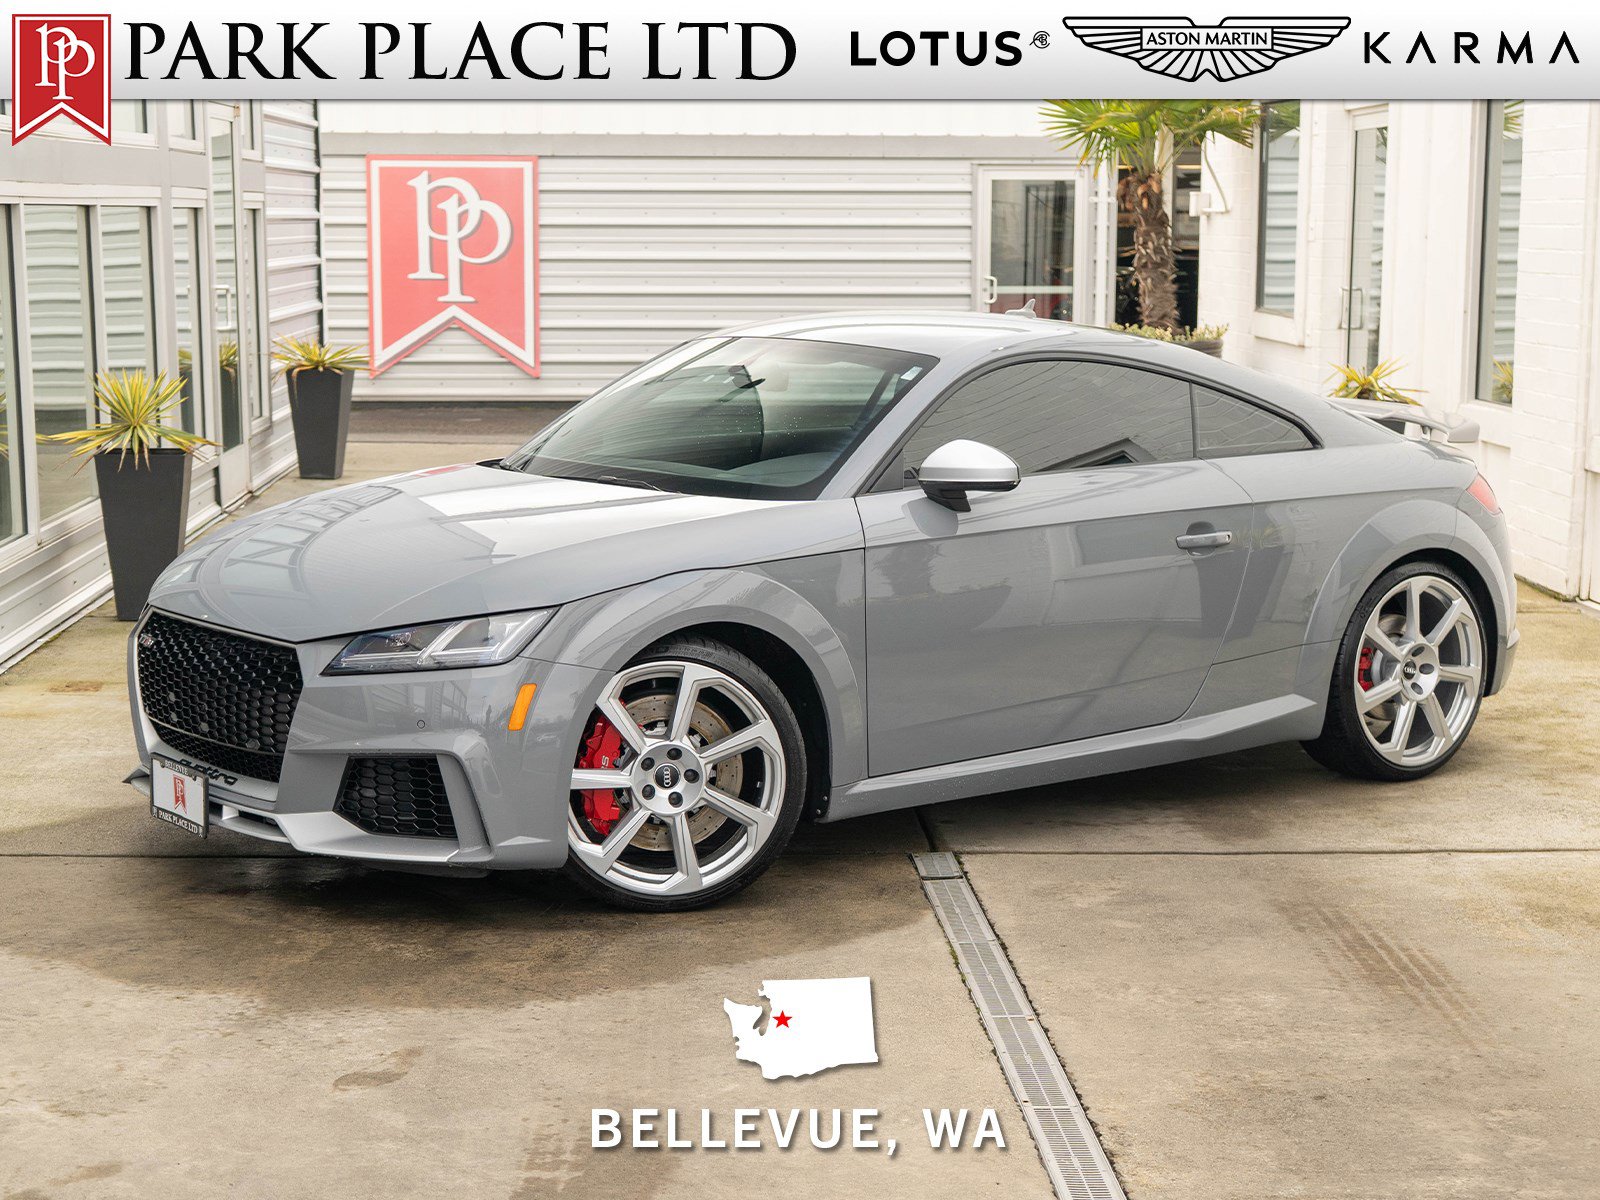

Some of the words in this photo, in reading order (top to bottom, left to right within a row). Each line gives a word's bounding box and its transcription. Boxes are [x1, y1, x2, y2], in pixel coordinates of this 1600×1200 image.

[158, 810, 172, 823] PARK
[172, 815, 188, 830] PLACE
[188, 822, 198, 834] LTD
